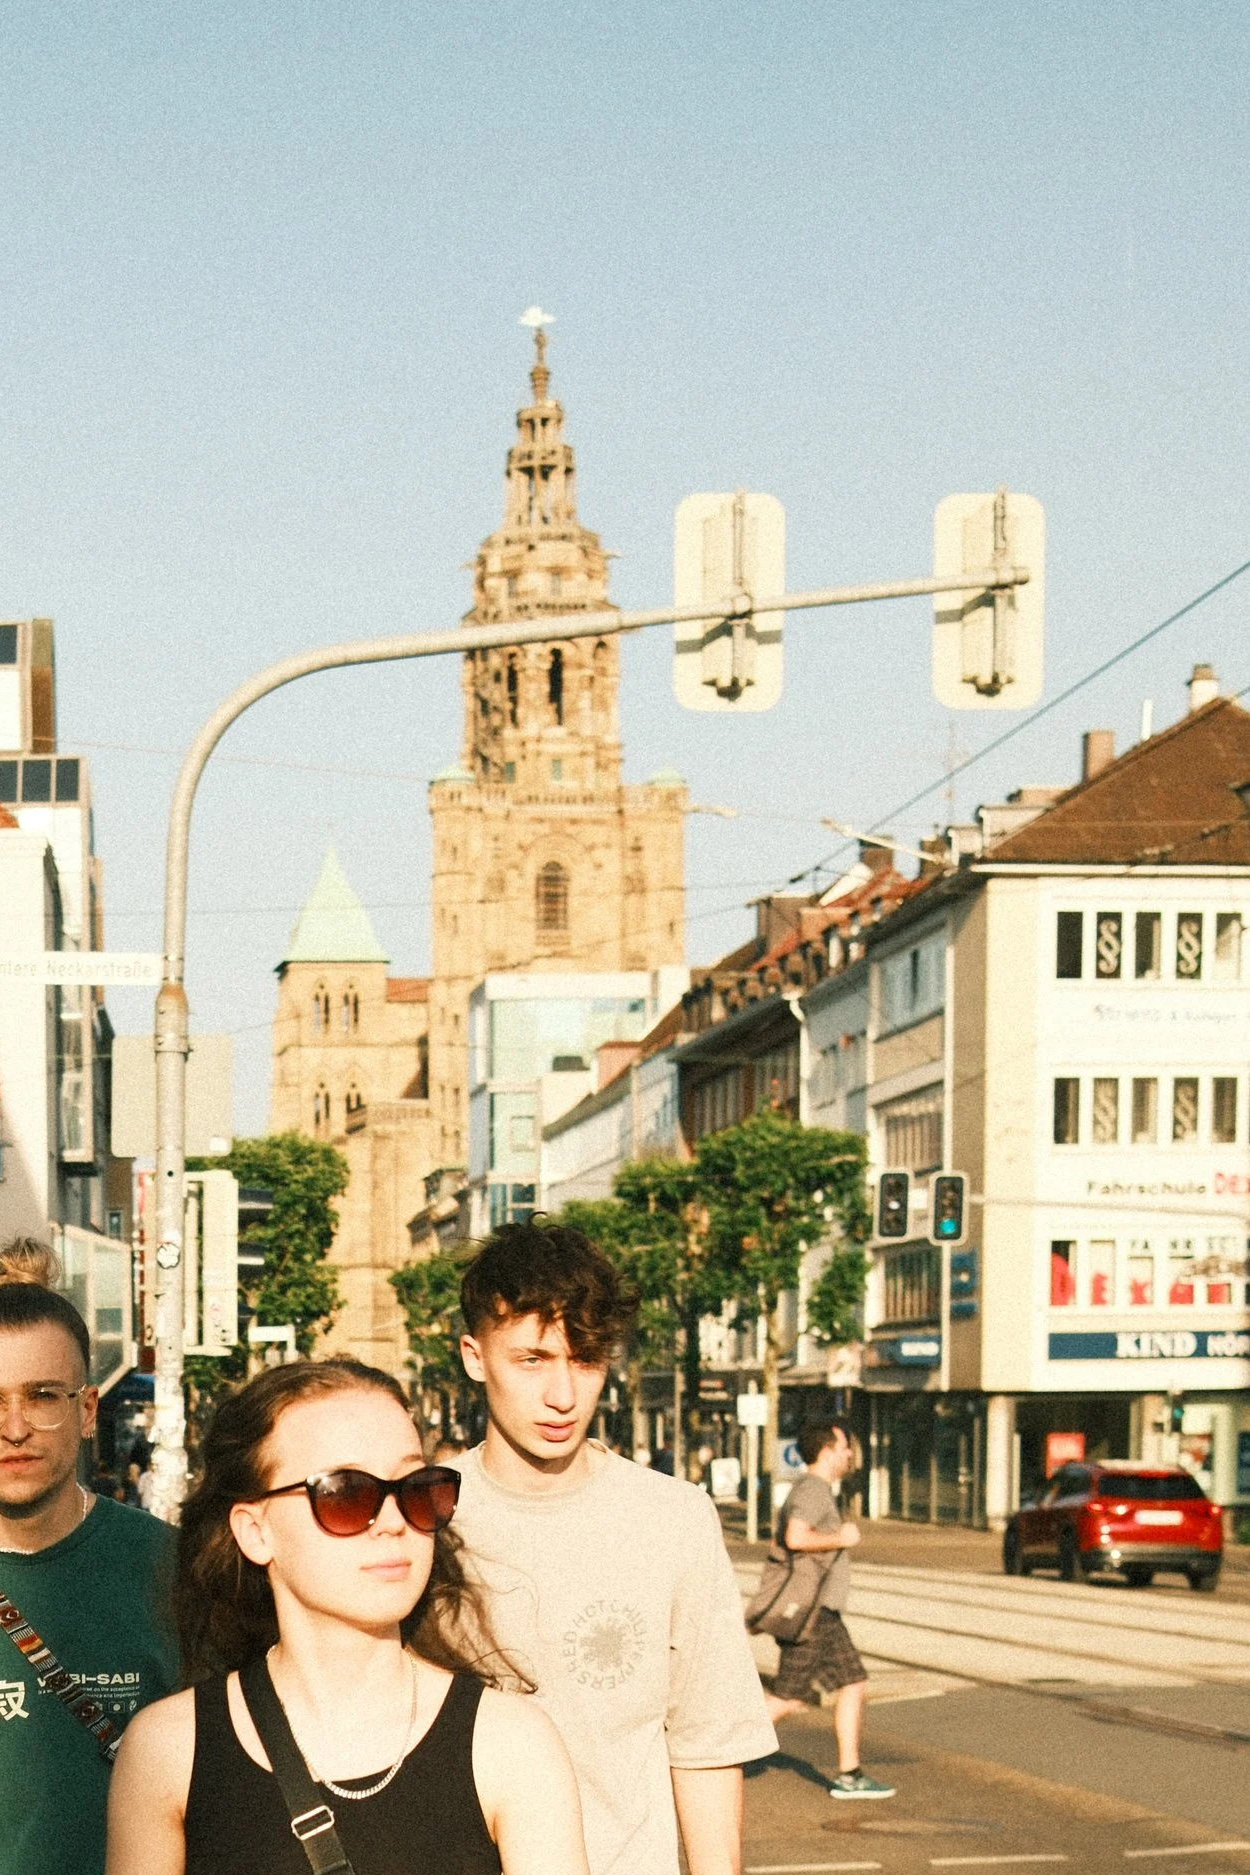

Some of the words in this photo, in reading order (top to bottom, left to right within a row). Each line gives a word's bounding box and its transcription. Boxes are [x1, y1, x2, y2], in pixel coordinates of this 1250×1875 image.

[1087, 1180, 1206, 1195] Fahrschule
[1117, 1332, 1197, 1358] KIND
[37, 1672, 140, 1688] WBI-SABI
